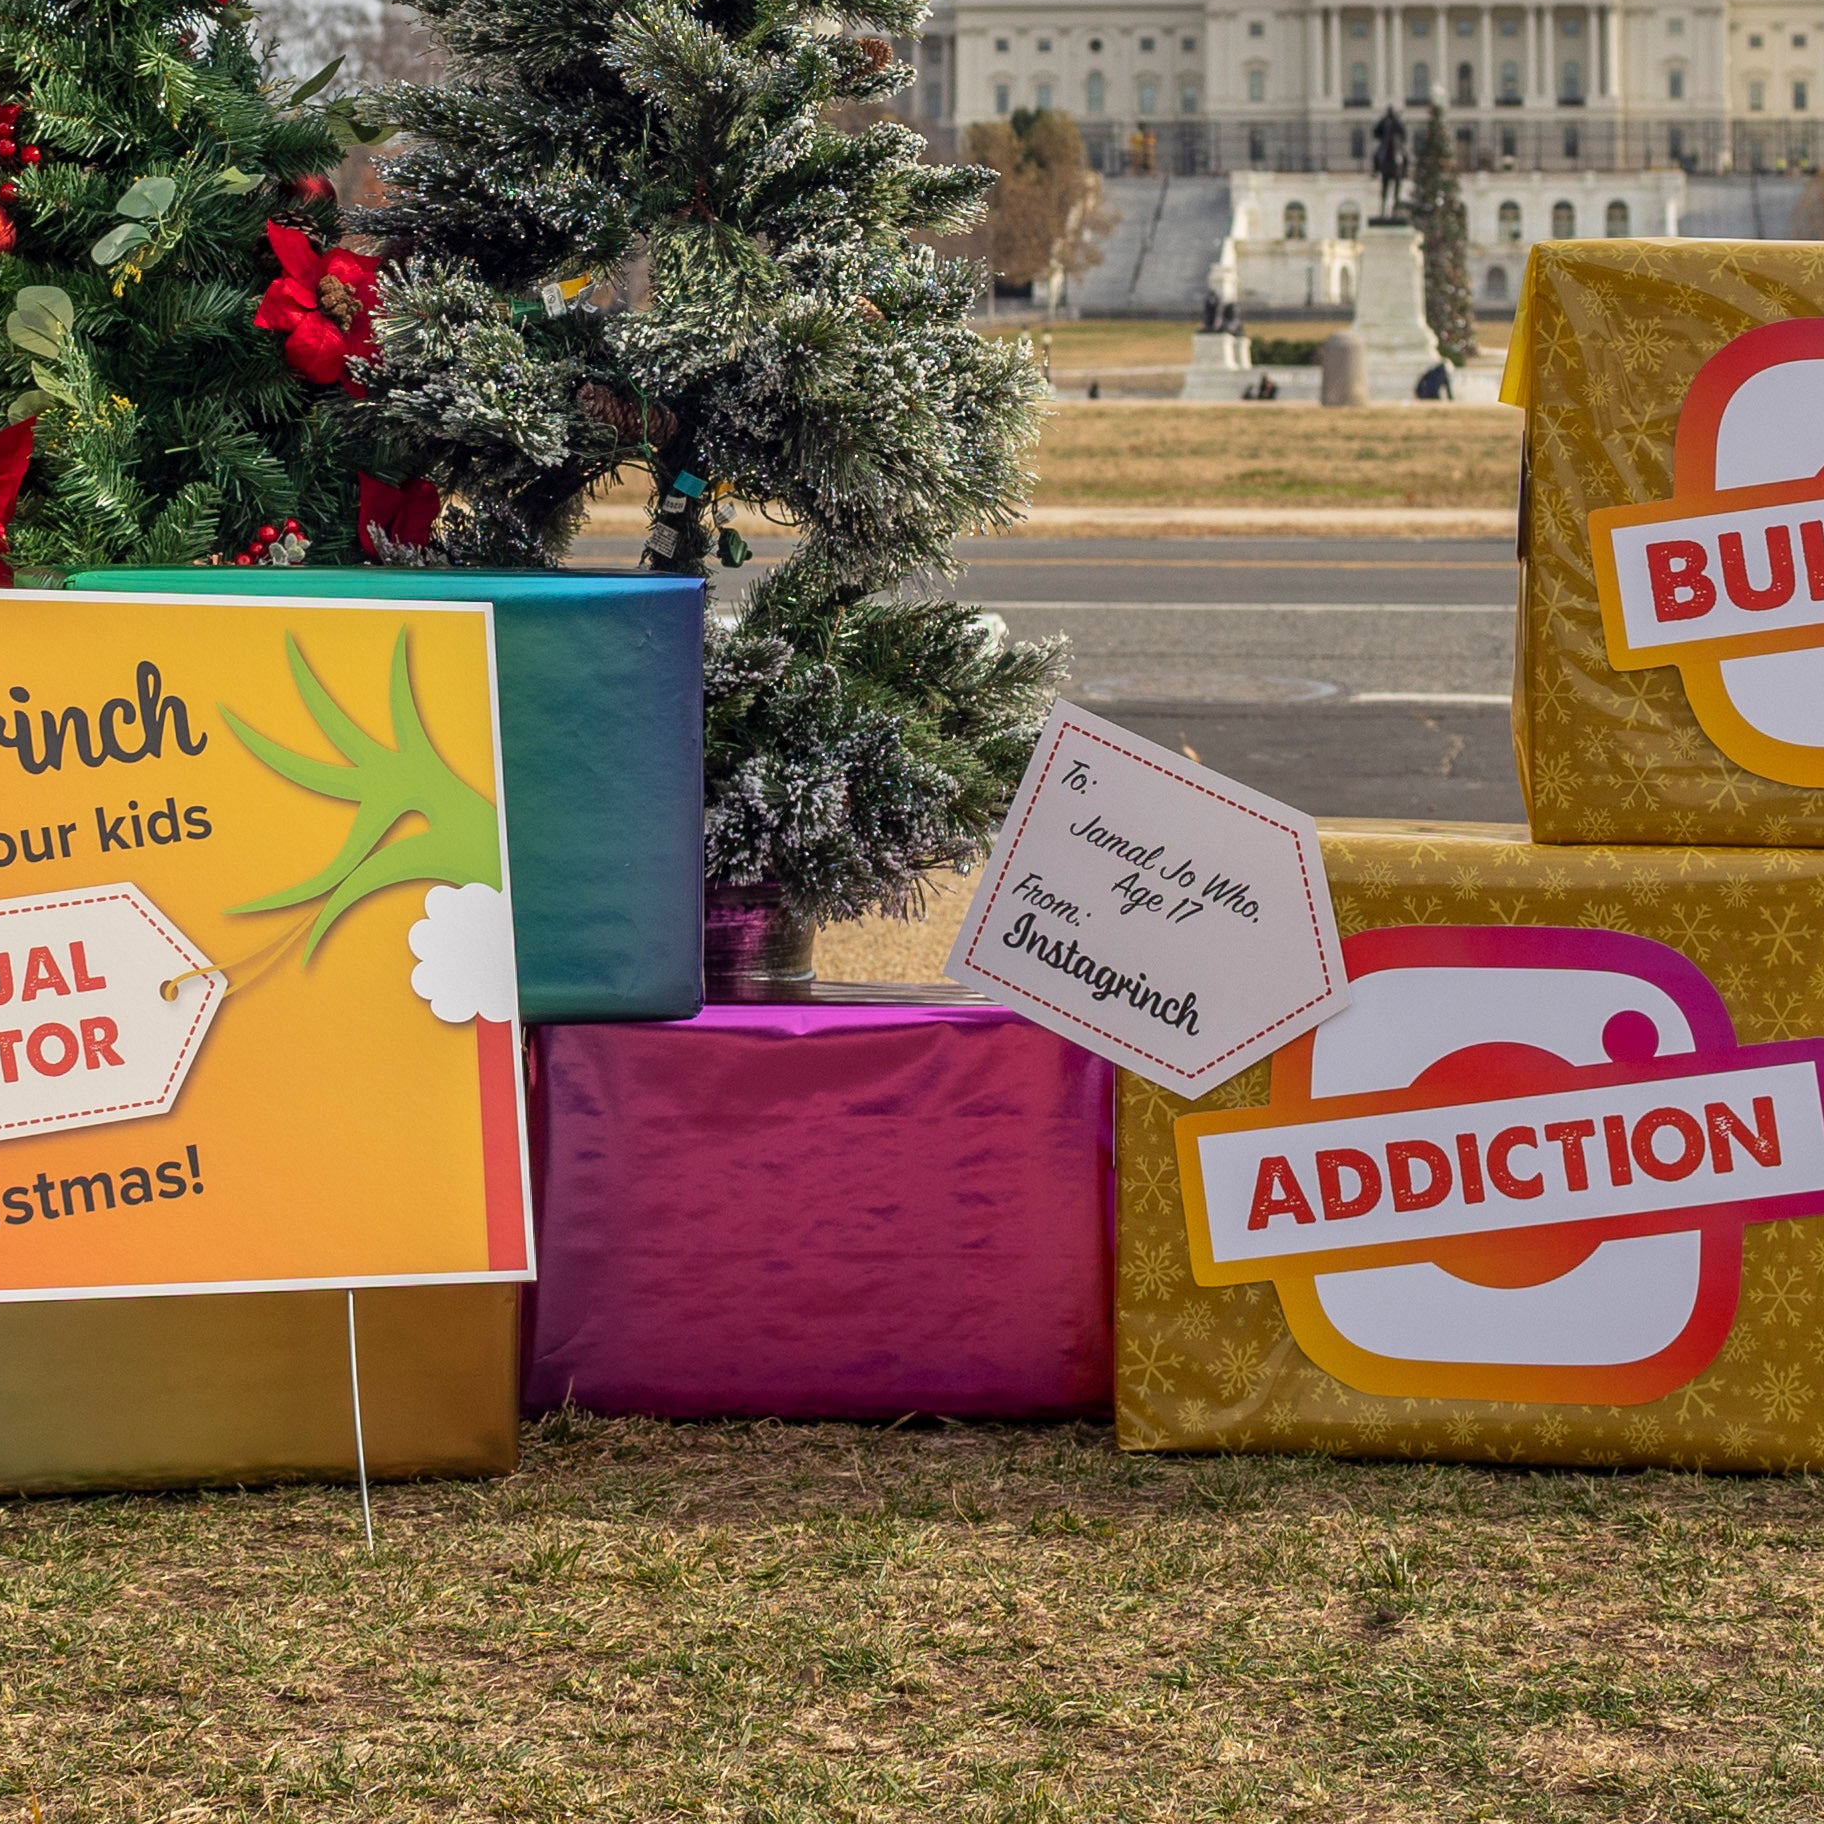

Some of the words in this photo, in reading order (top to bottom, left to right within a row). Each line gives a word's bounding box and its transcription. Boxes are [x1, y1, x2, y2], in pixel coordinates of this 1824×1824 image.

[1061, 759, 1098, 795] To:
[96, 798, 211, 852] kids
[1069, 815, 1165, 871] Jamal
[1159, 858, 1196, 888] Jo
[1011, 872, 1092, 927] From:
[1110, 871, 1164, 916] Age
[1165, 897, 1204, 924] 17
[1002, 912, 1200, 1037] Instagrinch
[1249, 1097, 1779, 1229] ADDICTION
